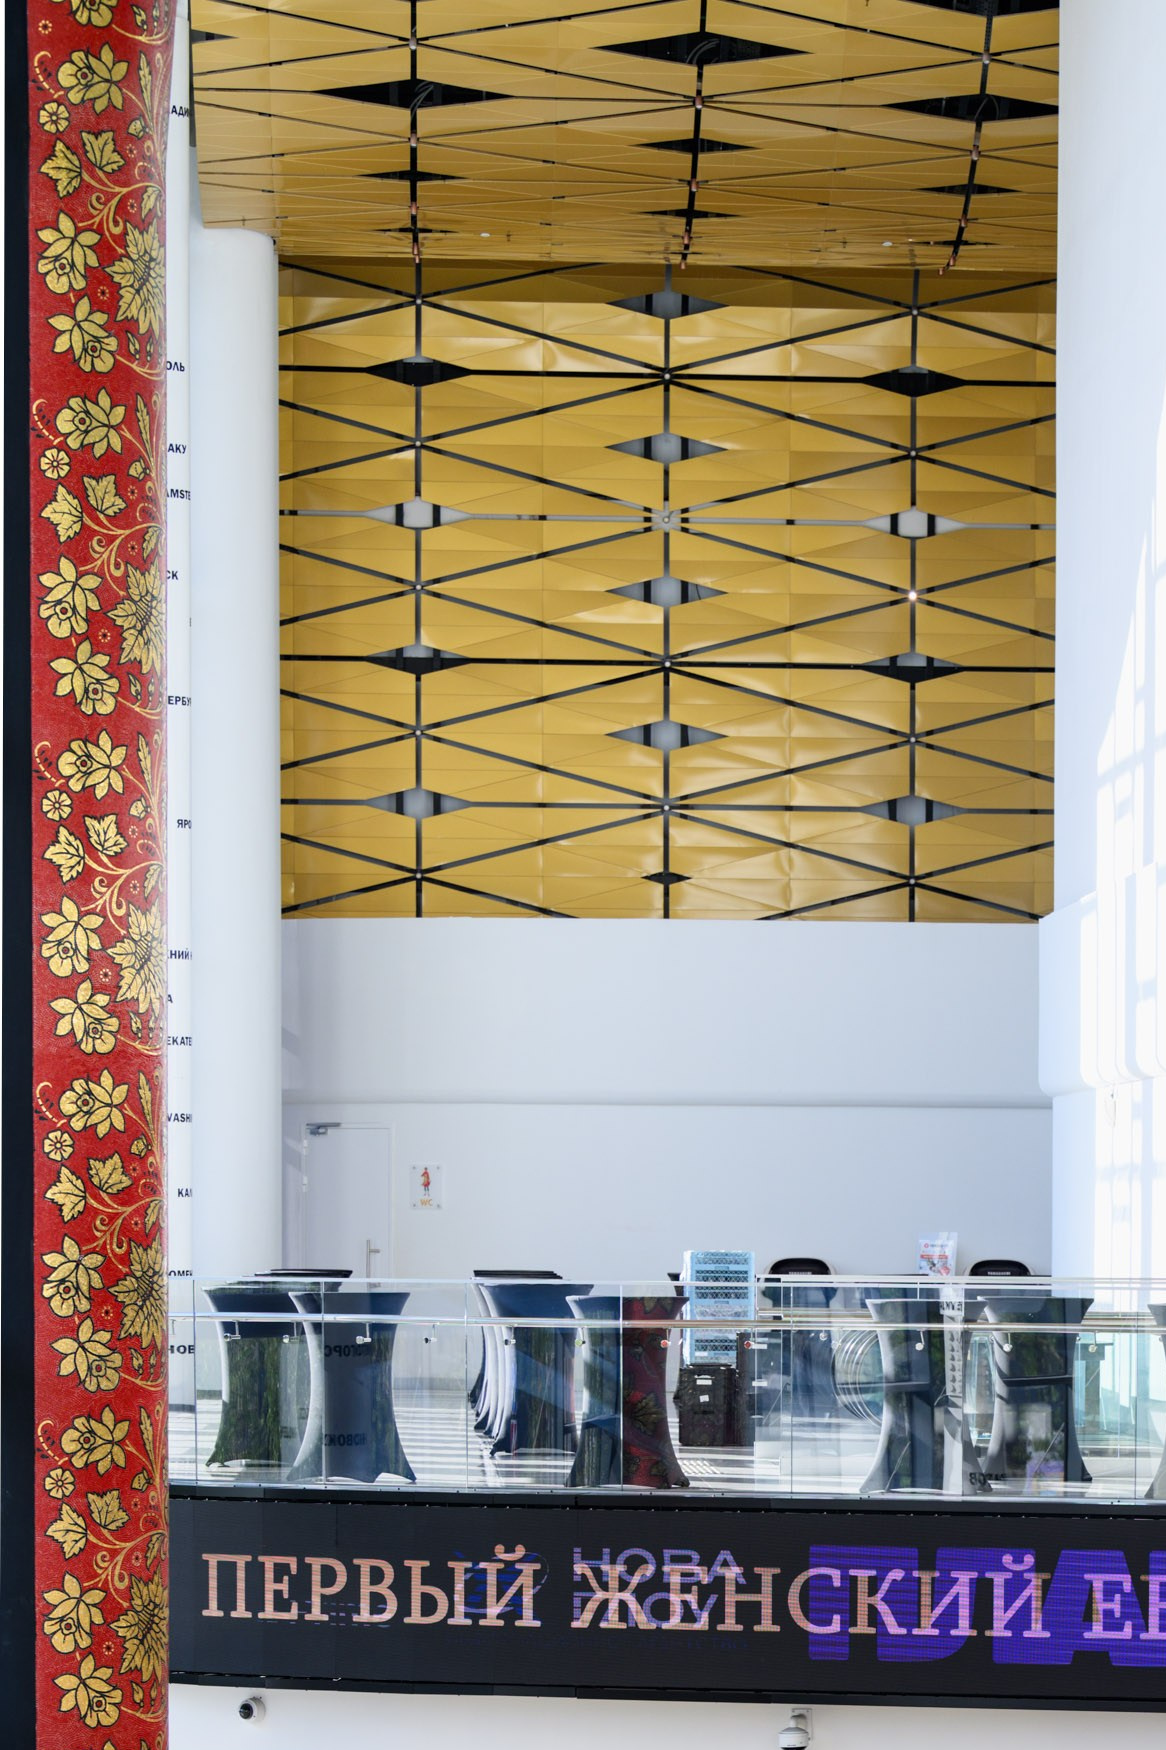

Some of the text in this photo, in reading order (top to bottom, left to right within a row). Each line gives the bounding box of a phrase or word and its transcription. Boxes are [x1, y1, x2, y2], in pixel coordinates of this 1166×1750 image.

[420, 1198, 433, 1207] WC
[201, 1544, 542, 1627] ПЕРВЫЙ
[571, 1553, 1051, 1639] ЖЕНСКИЙ
